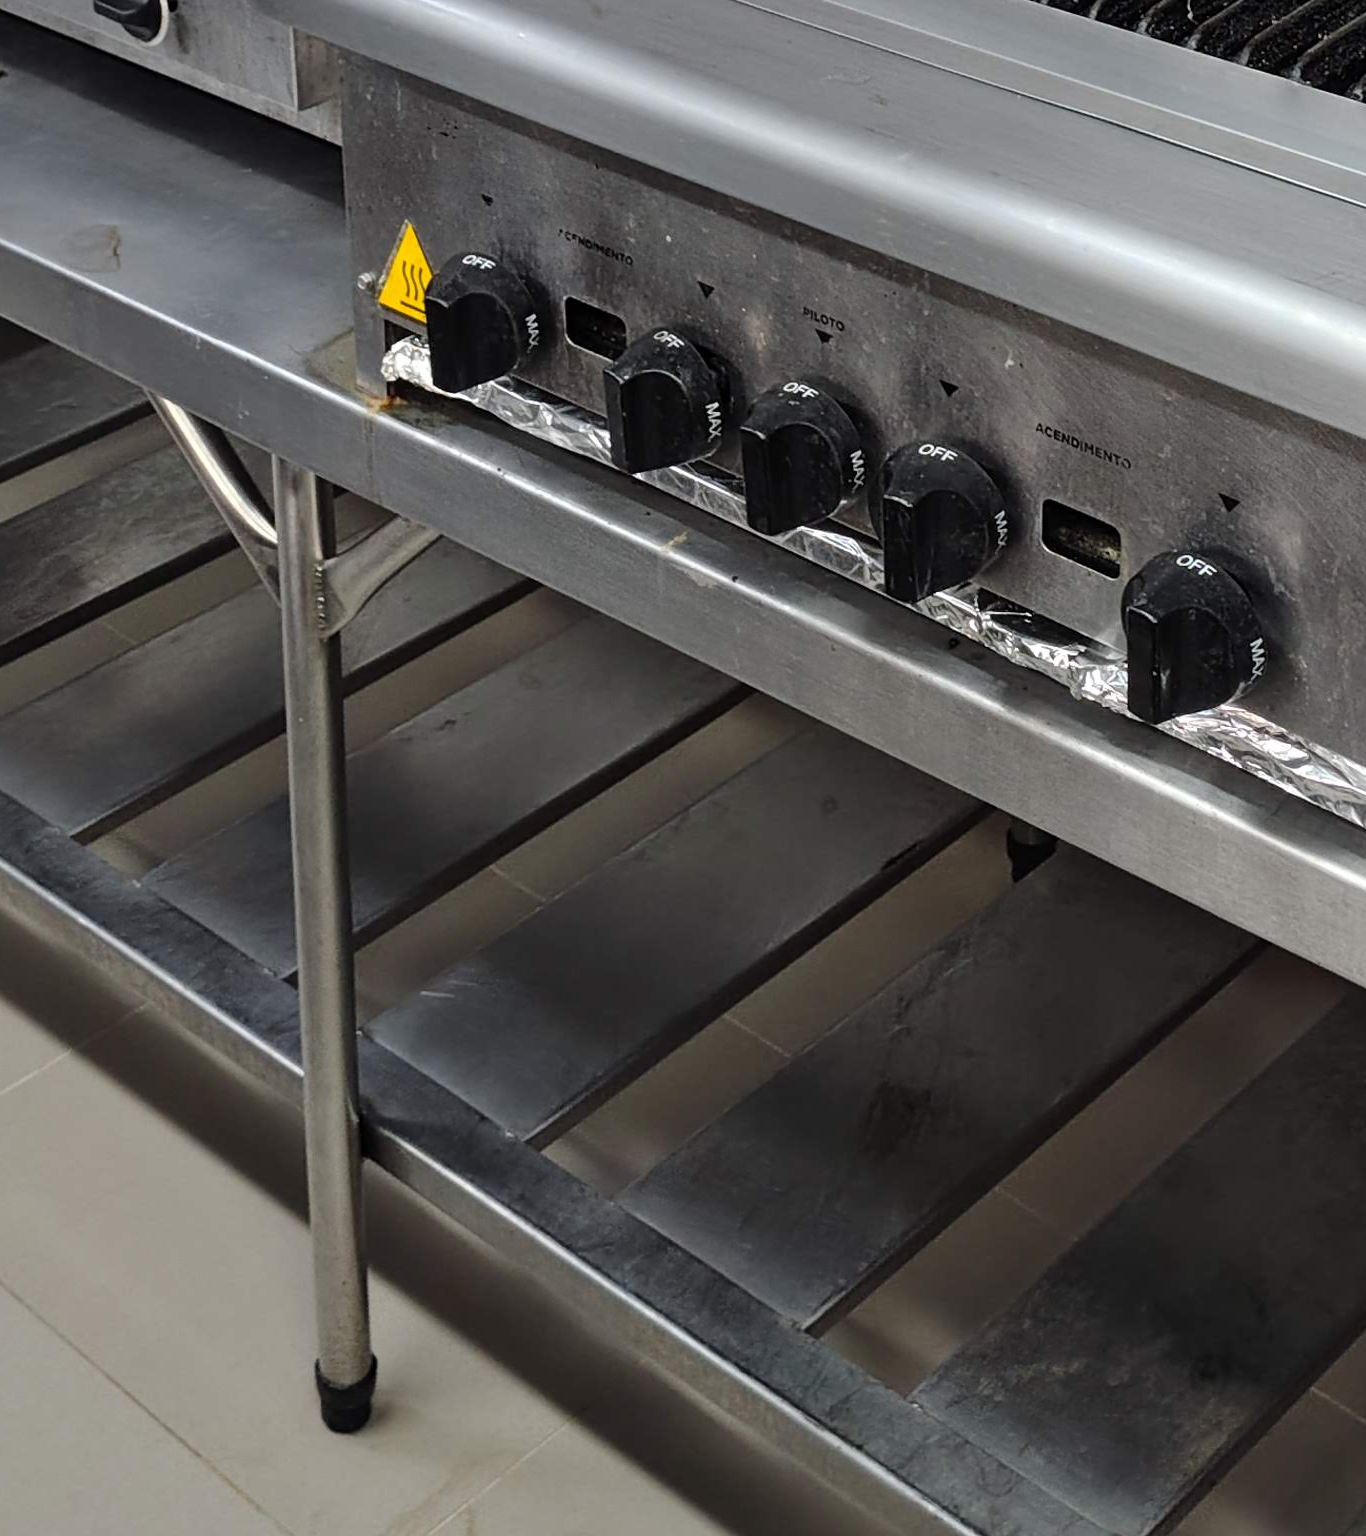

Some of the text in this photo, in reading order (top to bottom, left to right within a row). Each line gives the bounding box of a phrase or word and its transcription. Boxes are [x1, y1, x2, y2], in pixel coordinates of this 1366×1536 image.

[461, 254, 497, 270] OFF
[524, 313, 540, 354] MAX
[803, 306, 845, 332] PILOTO
[653, 330, 685, 349] OFF
[783, 382, 819, 399] OFF
[705, 401, 722, 443] MAX
[918, 443, 959, 463] OFF
[1035, 423, 1132, 470] ACENDIMENTO
[850, 449, 865, 494] MAX
[994, 510, 1009, 558] MAX
[1176, 554, 1218, 576] OFF
[1249, 637, 1266, 682] MAX
